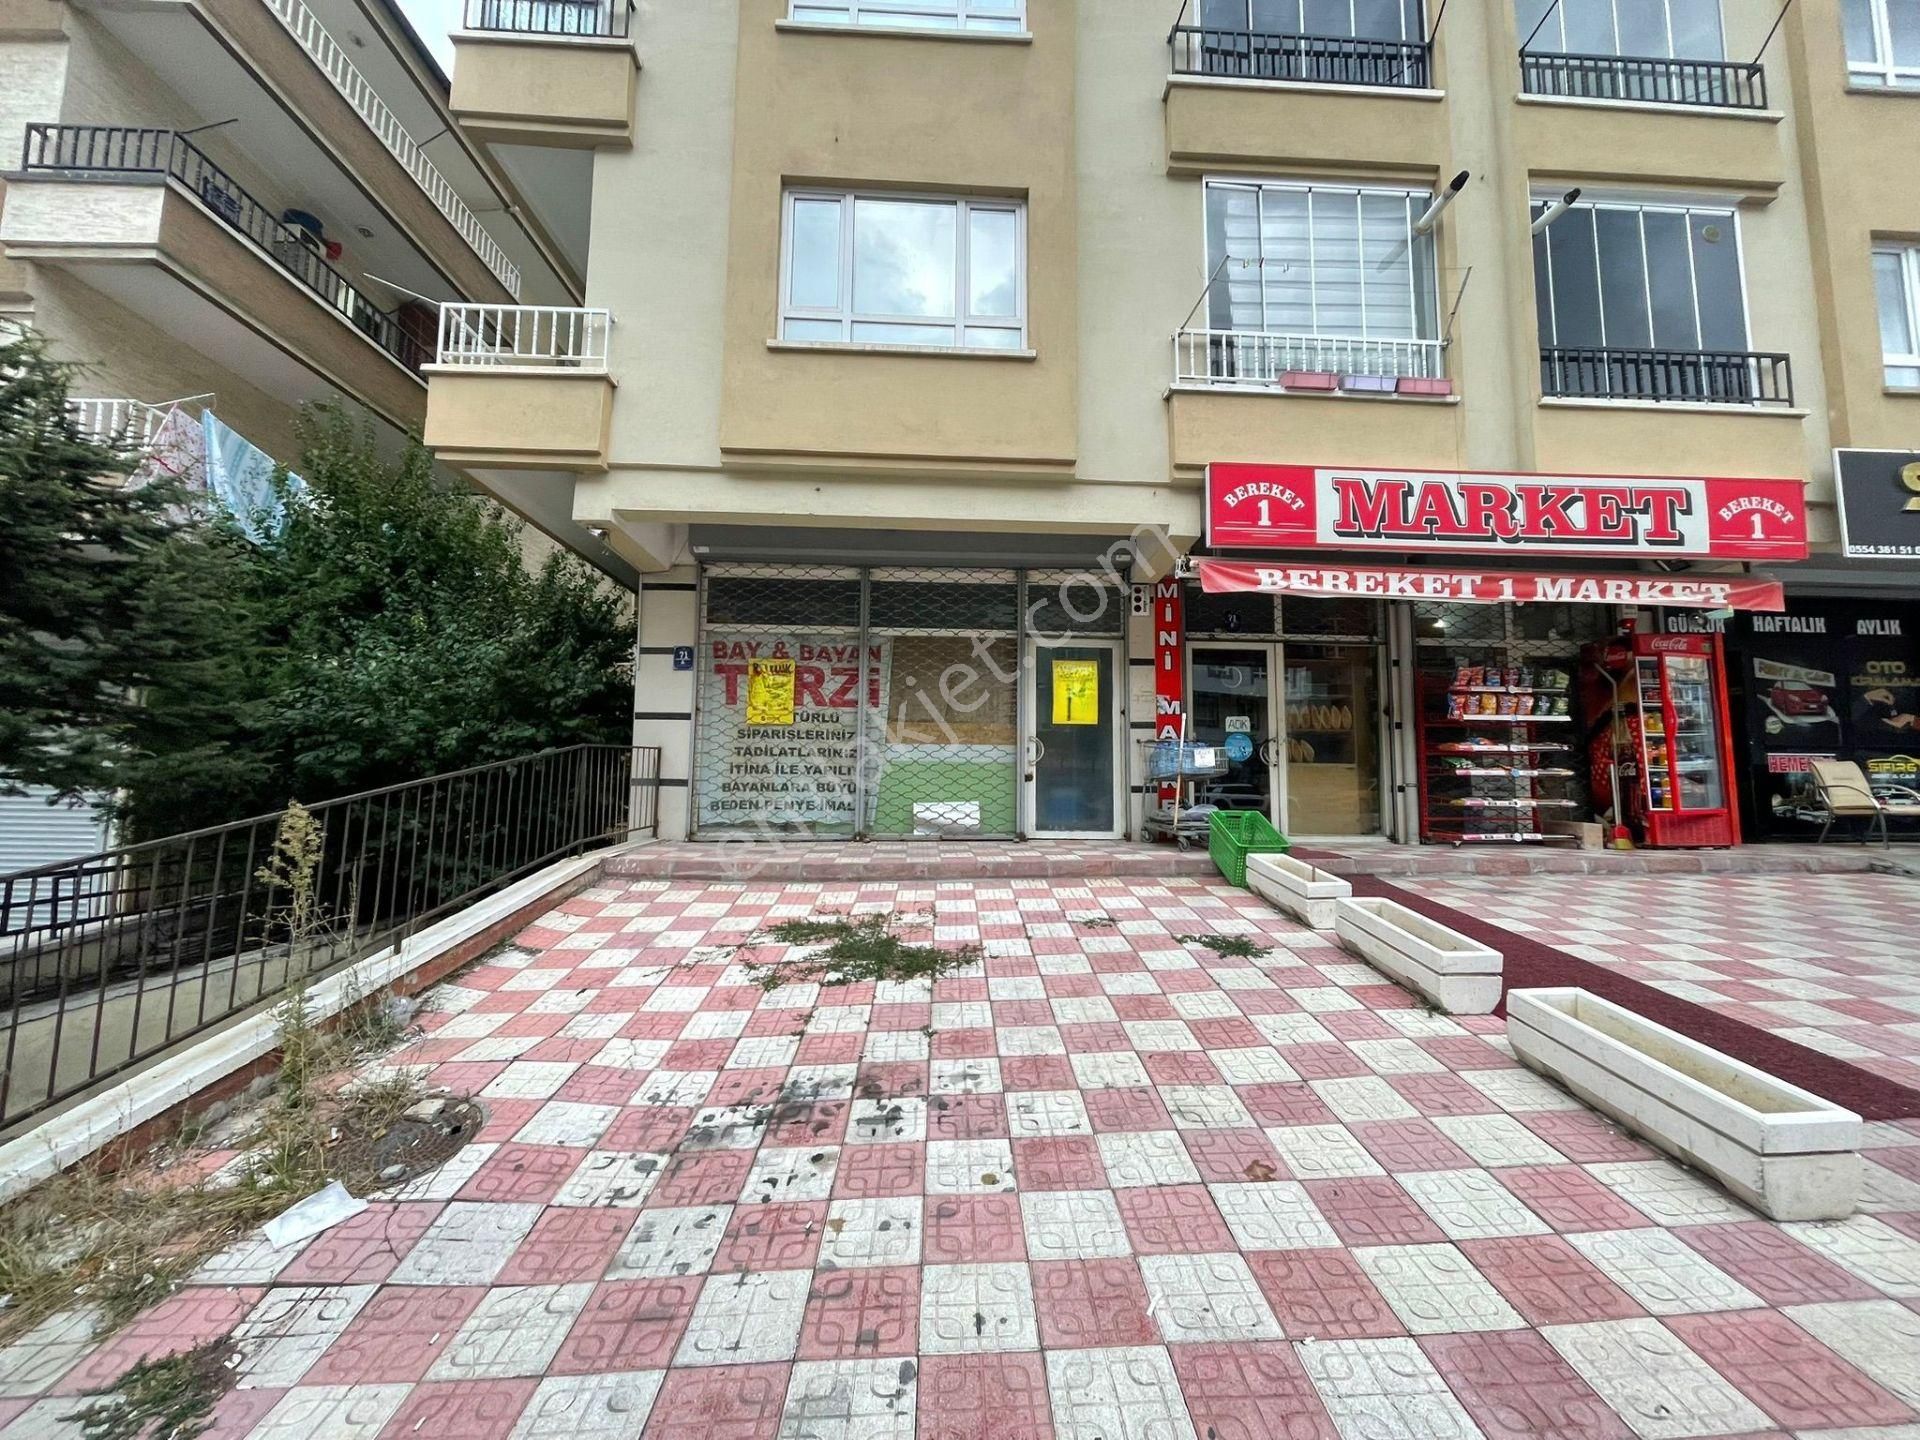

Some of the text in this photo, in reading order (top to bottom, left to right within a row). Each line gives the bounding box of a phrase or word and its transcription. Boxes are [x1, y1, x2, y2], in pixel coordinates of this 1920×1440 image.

[1223, 481, 1305, 512] BEREKET
[1718, 496, 1795, 524] BEREKET
[1256, 499, 1273, 527] 1
[1332, 477, 1692, 546] MARKET
[1750, 512, 1765, 540] 1
[1254, 568, 1732, 605] BEREKET 1 MARKET
[1753, 615, 1827, 634] HAFTALIK
[1857, 619, 1902, 636] AYLIK
[713, 640, 762, 660] BAY
[799, 645, 882, 663] BAYAN
[714, 663, 881, 709] TRZİ
[1767, 756, 1810, 772] HEME
[710, 800, 760, 812] BEDEN
